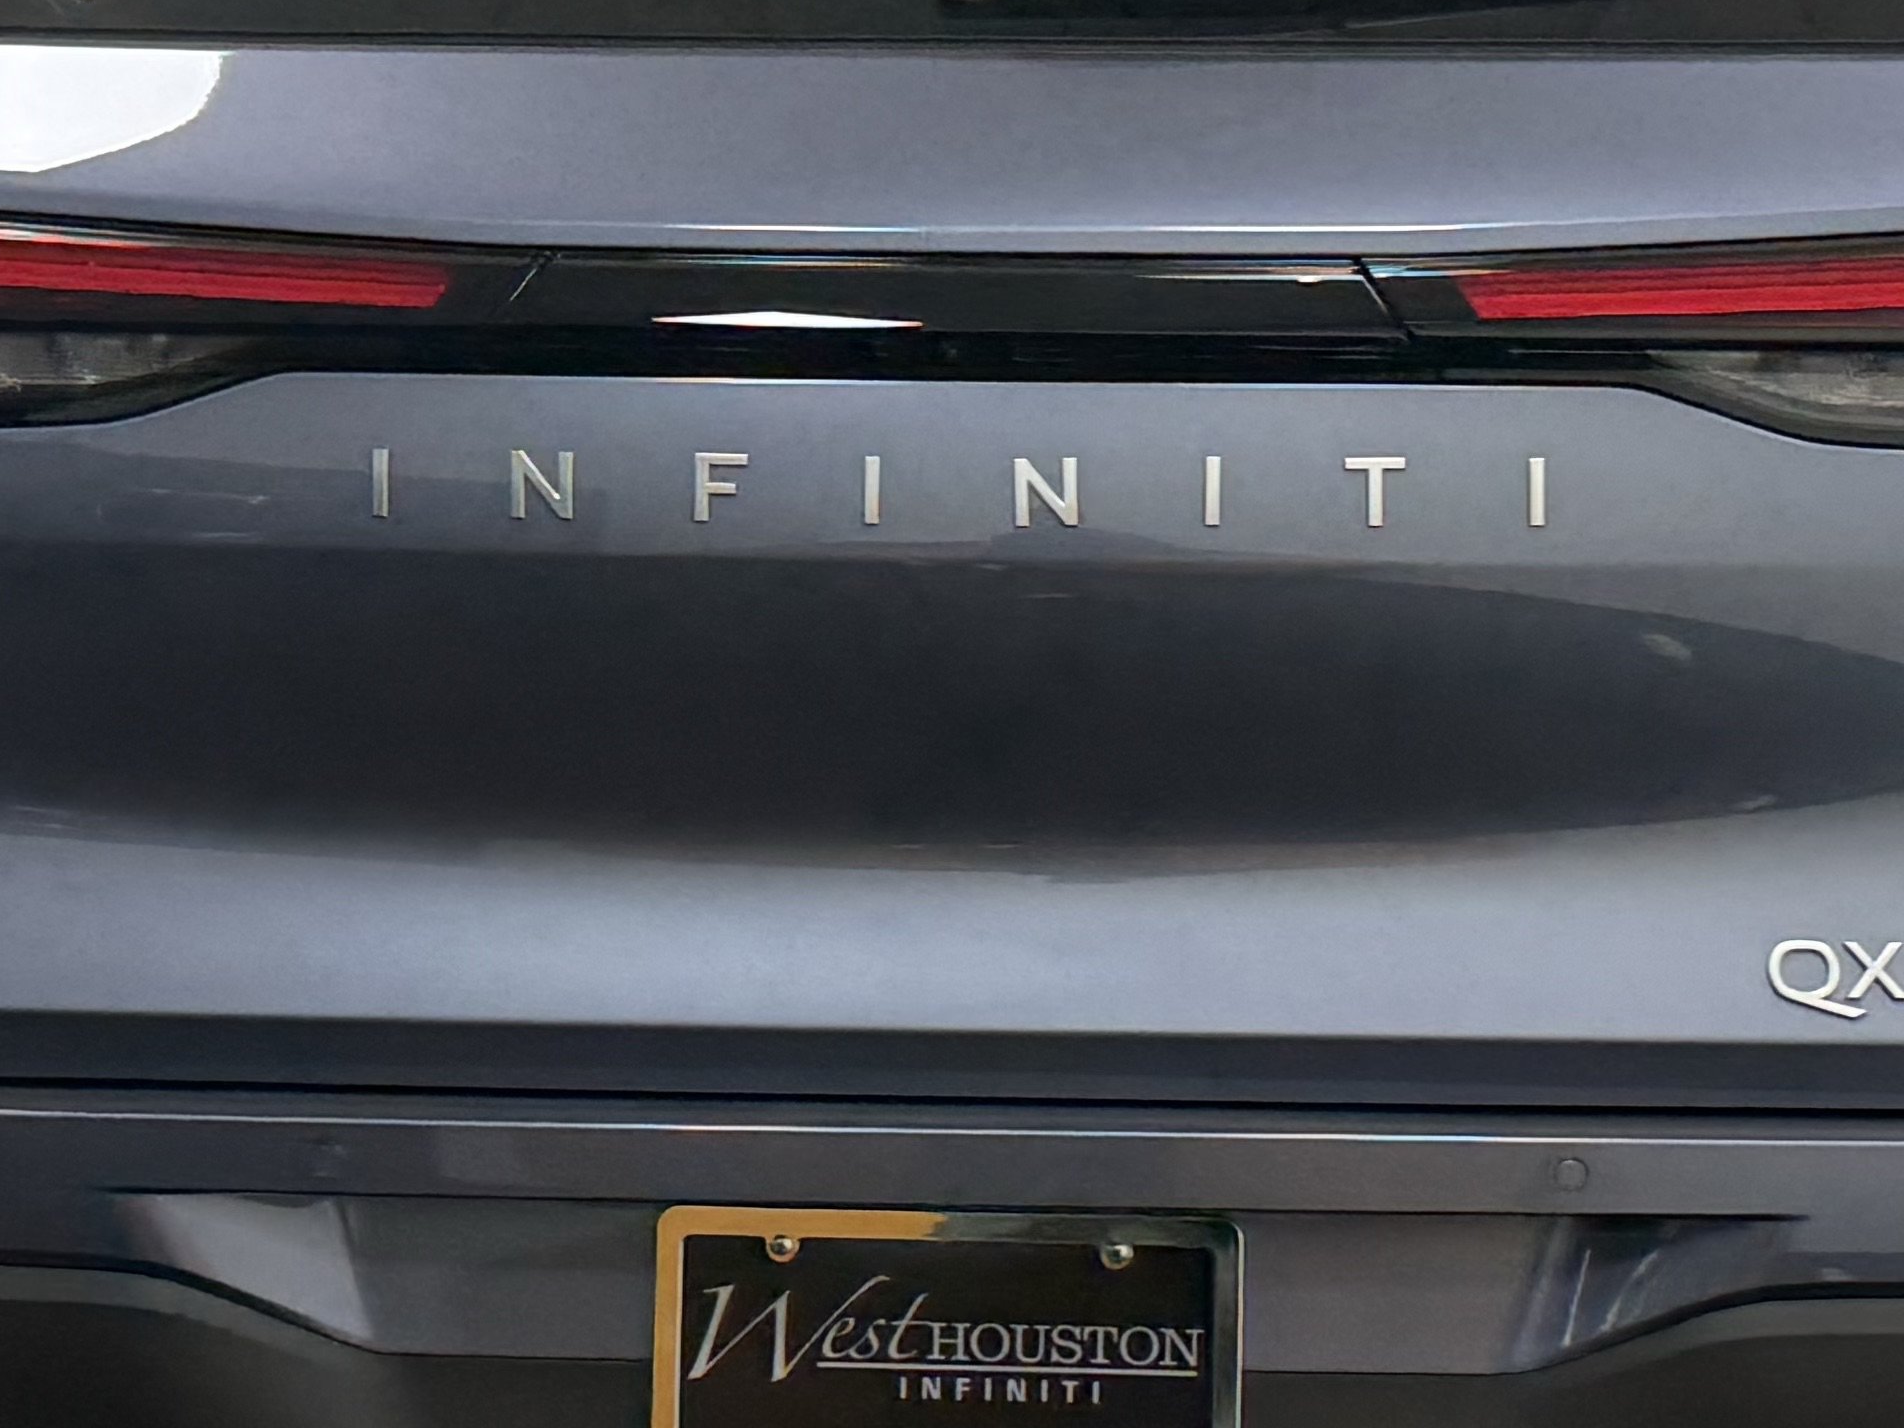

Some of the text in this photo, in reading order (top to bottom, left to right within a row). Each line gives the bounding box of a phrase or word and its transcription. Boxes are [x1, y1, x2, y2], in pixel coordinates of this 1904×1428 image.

[371, 447, 1546, 528] INFINITI
[686, 1275, 1206, 1384] West HOUSTON
[898, 1376, 1102, 1405] INFINITI
